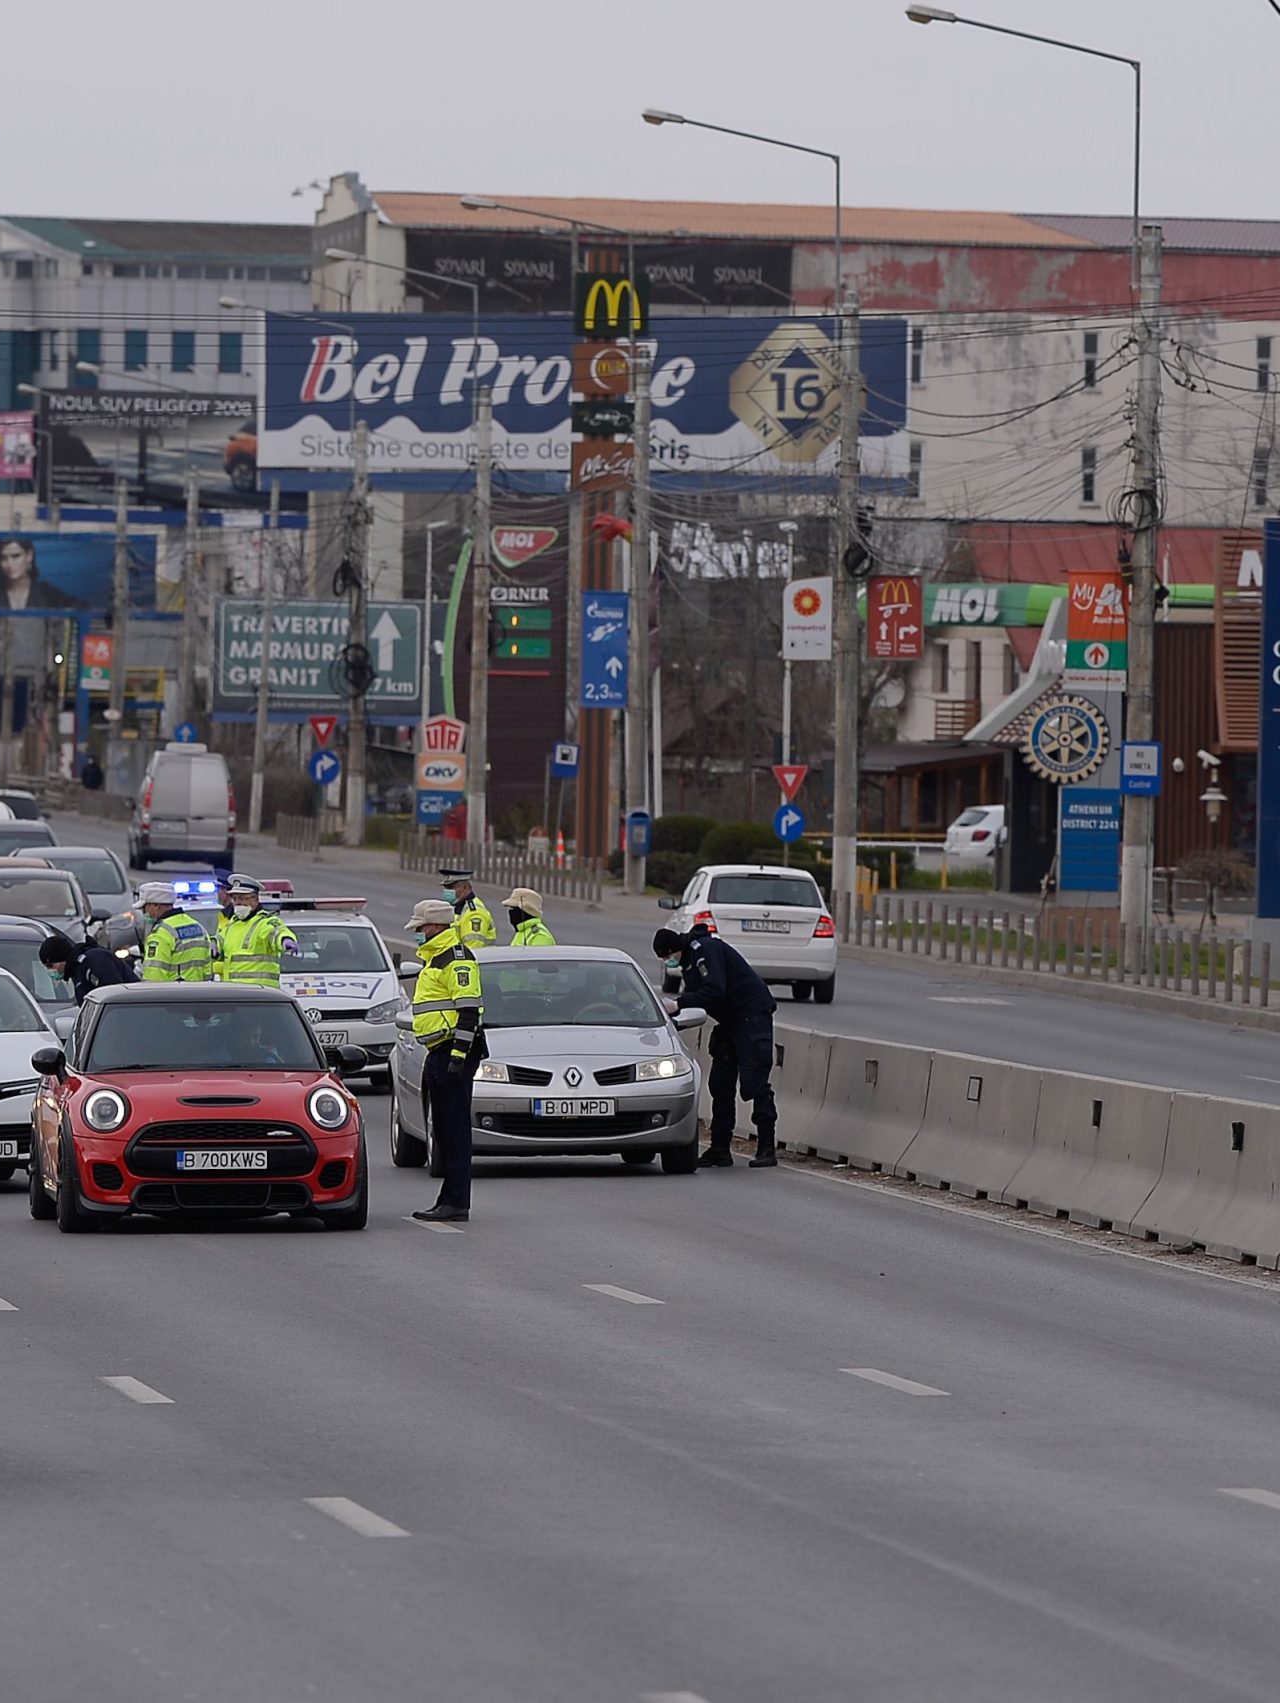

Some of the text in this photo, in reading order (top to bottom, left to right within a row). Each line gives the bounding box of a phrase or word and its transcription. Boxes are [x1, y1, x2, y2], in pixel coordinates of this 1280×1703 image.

[300, 335, 428, 405] Bel
[770, 373, 825, 412] 16
[100, 396, 132, 411] SUV
[500, 531, 535, 549] MOL
[931, 588, 1000, 623] MOL
[387, 678, 414, 694] km
[425, 766, 458, 777] DKV
[545, 1101, 609, 1115] B 01 MPD
[184, 1153, 195, 1168] B
